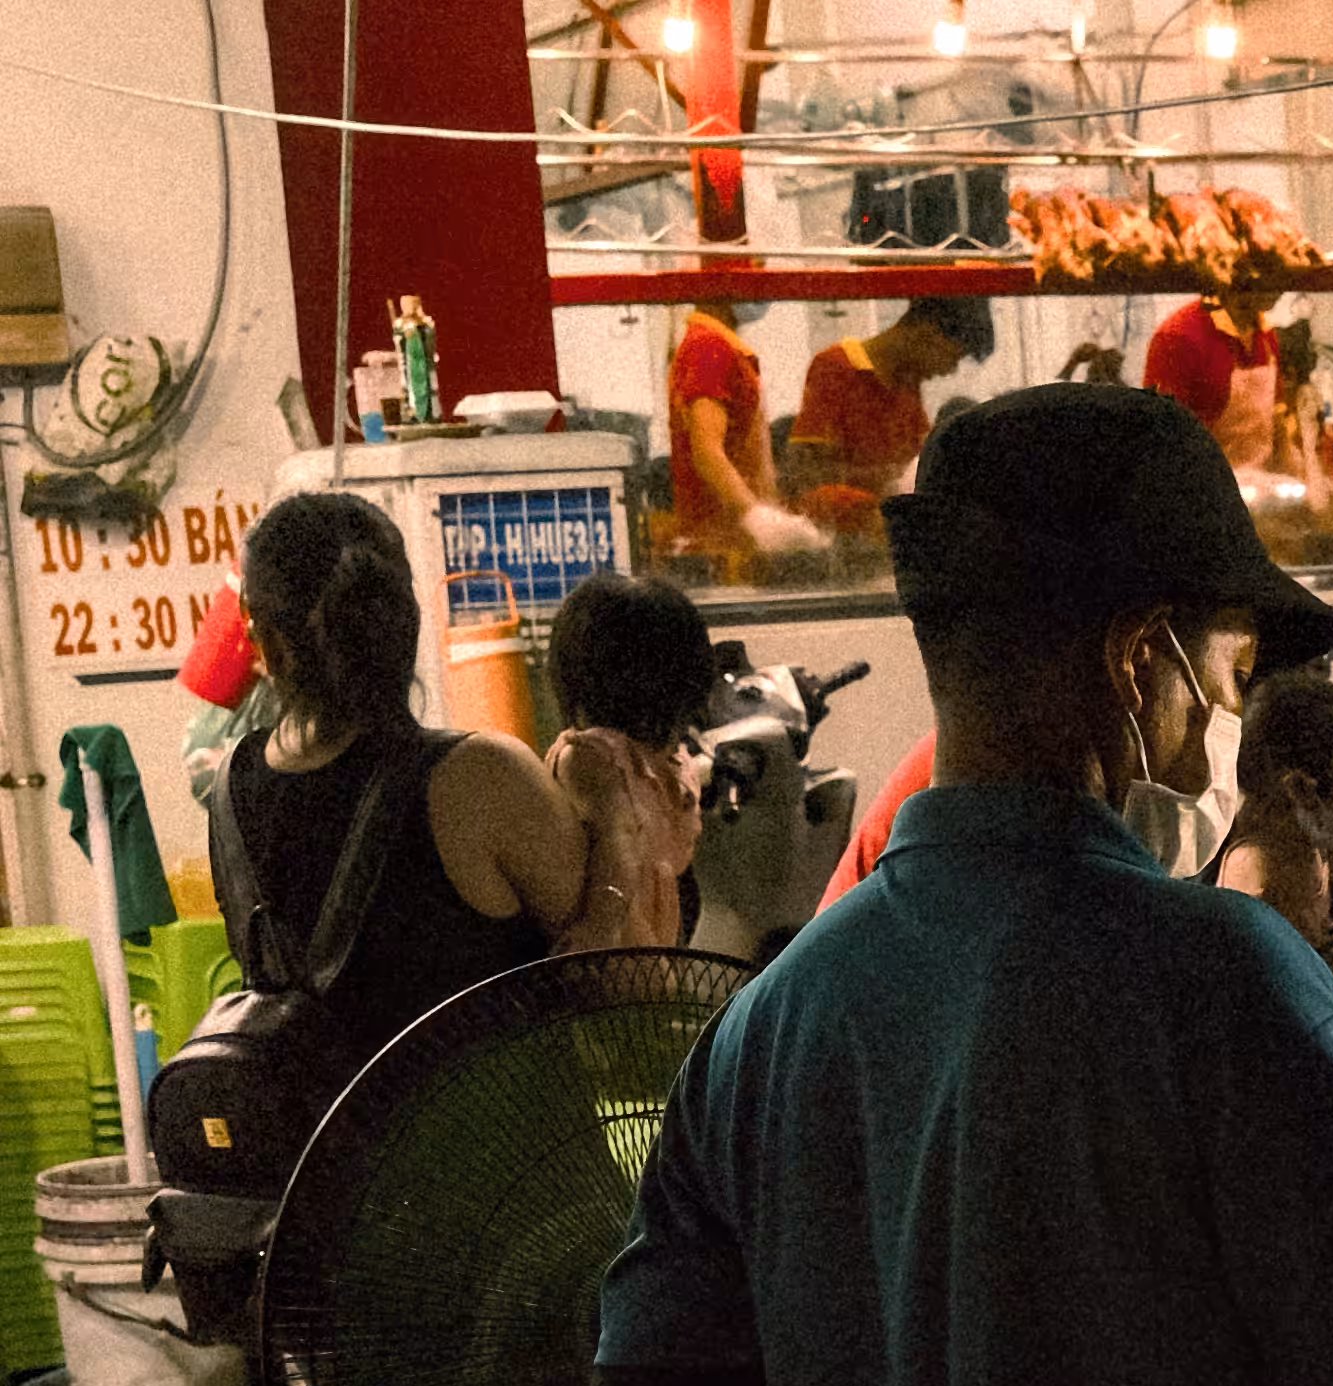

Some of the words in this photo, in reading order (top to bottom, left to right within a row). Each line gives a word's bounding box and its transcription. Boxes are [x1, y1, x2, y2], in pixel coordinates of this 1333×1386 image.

[36, 515, 84, 573] 10
[50, 601, 97, 657] 22
[132, 596, 177, 650] 30
